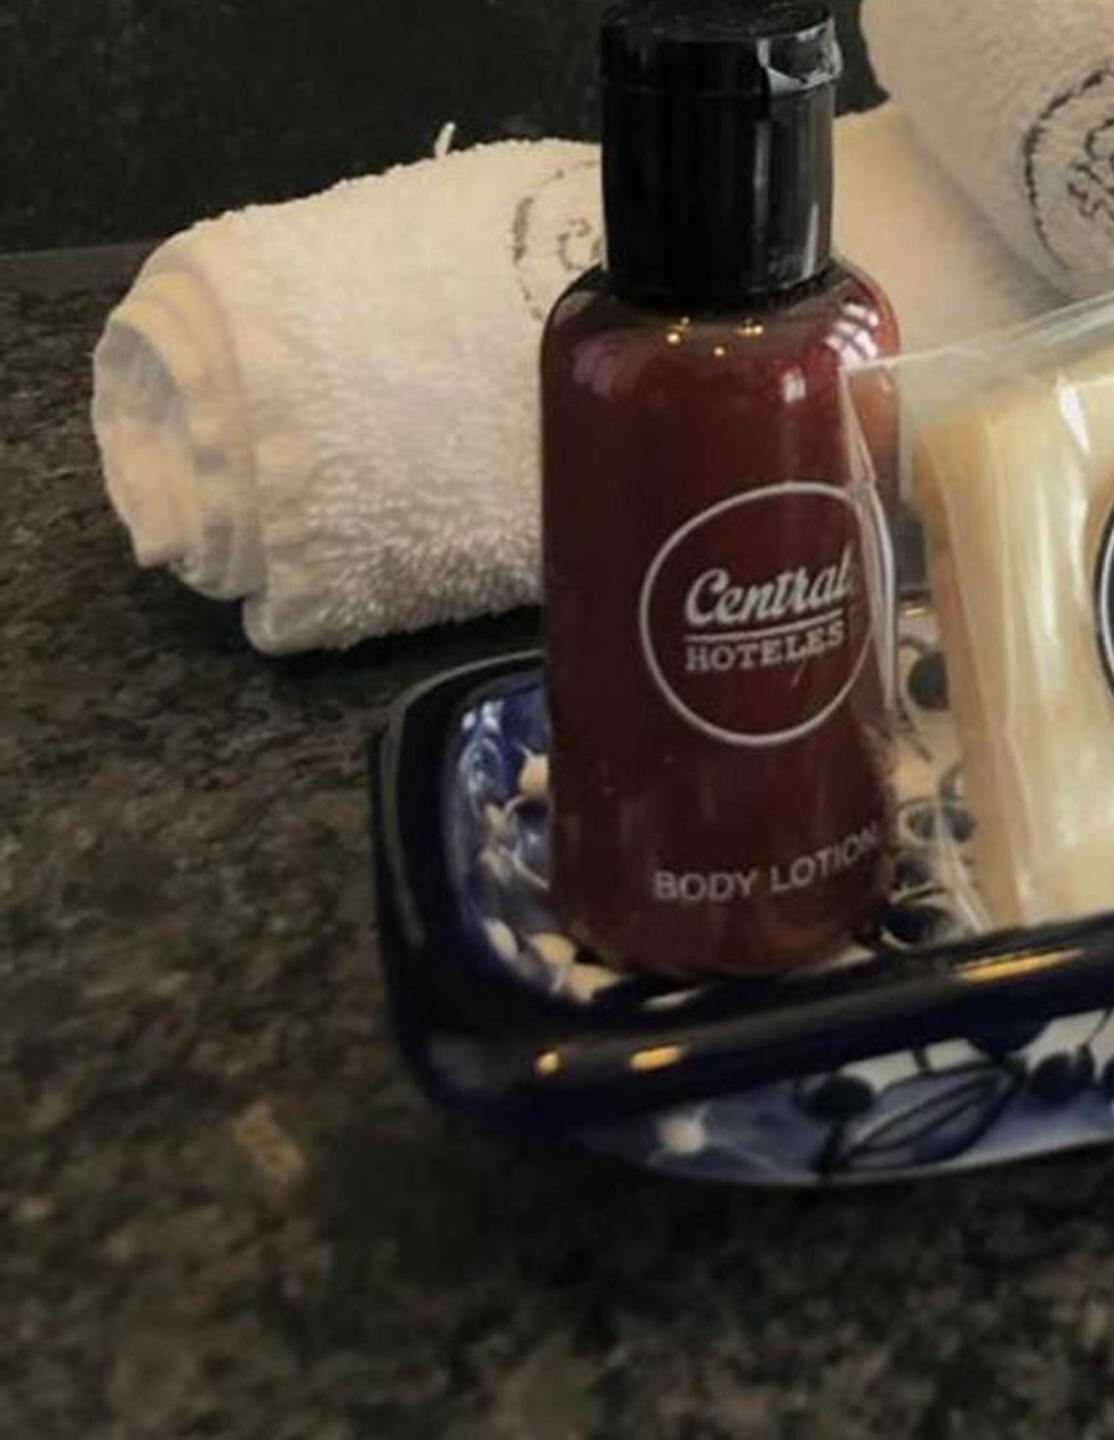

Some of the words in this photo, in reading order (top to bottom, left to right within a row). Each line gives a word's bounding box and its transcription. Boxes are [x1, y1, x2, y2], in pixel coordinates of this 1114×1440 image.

[684, 540, 857, 627] Central
[685, 620, 846, 673] HOTELES
[653, 869, 758, 902] BODY
[769, 820, 878, 893] LOTION
